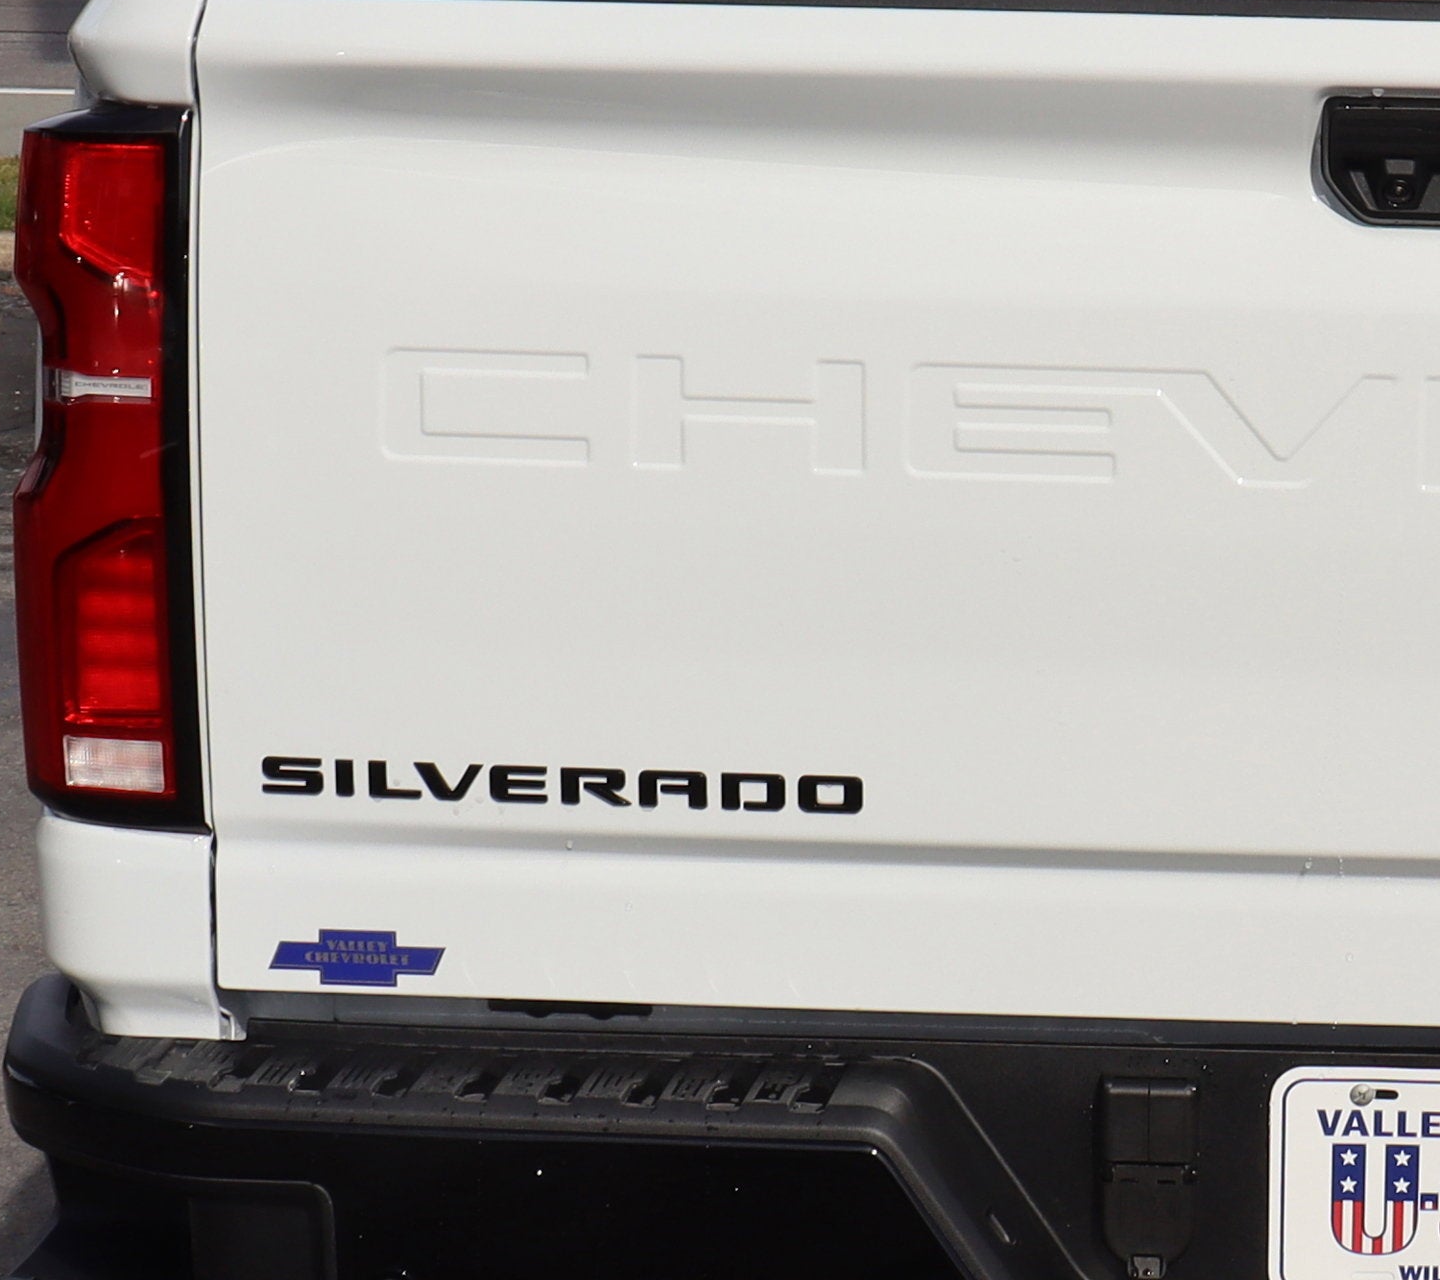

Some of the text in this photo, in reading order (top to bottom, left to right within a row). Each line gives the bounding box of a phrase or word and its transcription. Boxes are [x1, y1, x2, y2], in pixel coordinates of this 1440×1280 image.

[261, 755, 864, 815] SILVERADO
[326, 939, 388, 952] VALLEY
[304, 950, 409, 966] CHEVROLET
